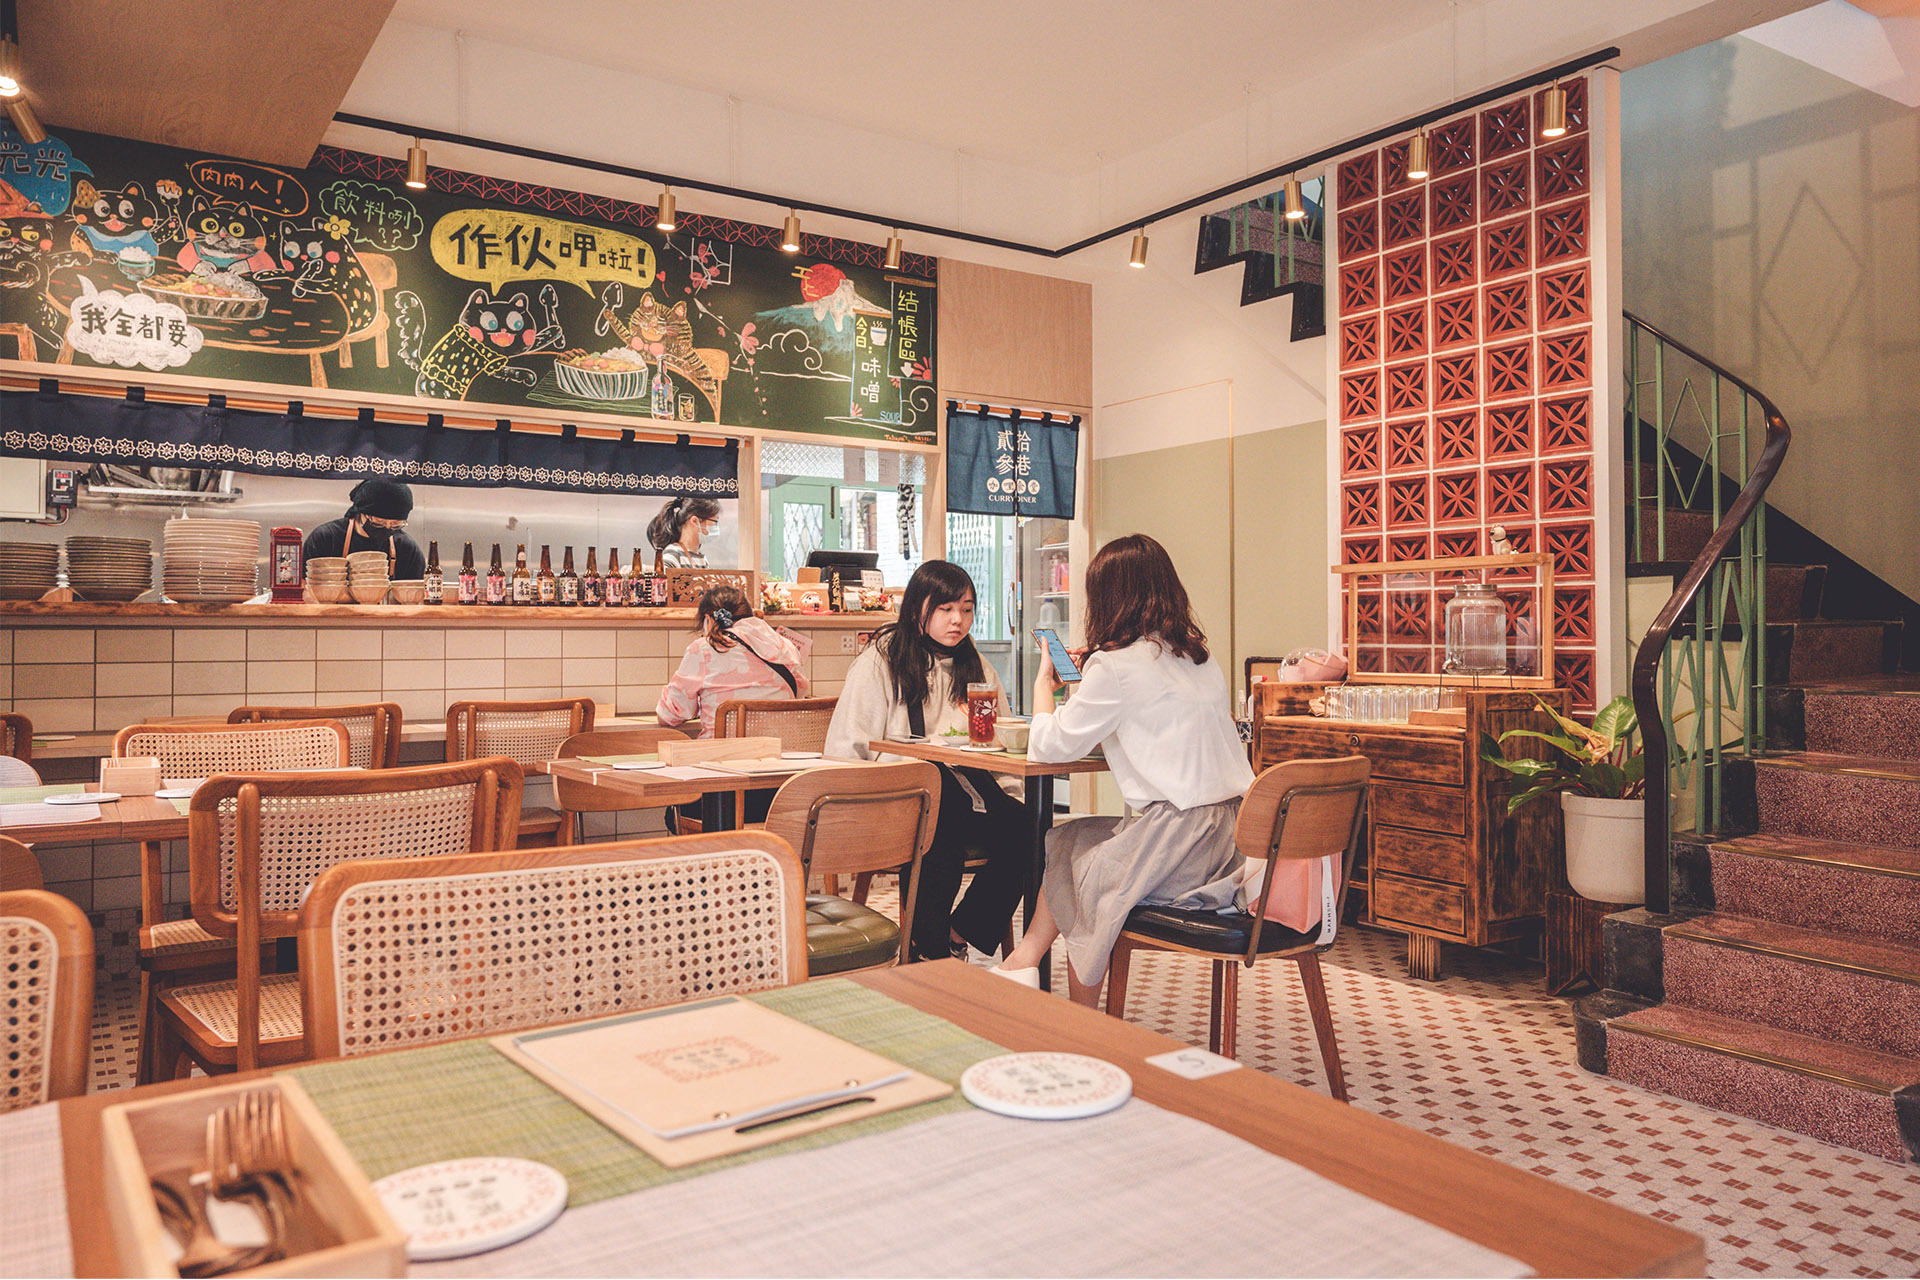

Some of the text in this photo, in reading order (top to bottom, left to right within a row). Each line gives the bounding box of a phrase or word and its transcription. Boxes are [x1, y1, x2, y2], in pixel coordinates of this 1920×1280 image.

[448, 222, 647, 279] 作伙呷啦!
[79, 302, 188, 349] 我全都要
[860, 357, 882, 403] 味噌
[880, 410, 900, 423] SOUP
[996, 429, 1032, 453] 貳拾
[995, 453, 1032, 476] 參巷
[988, 494, 1014, 503] CURRY
